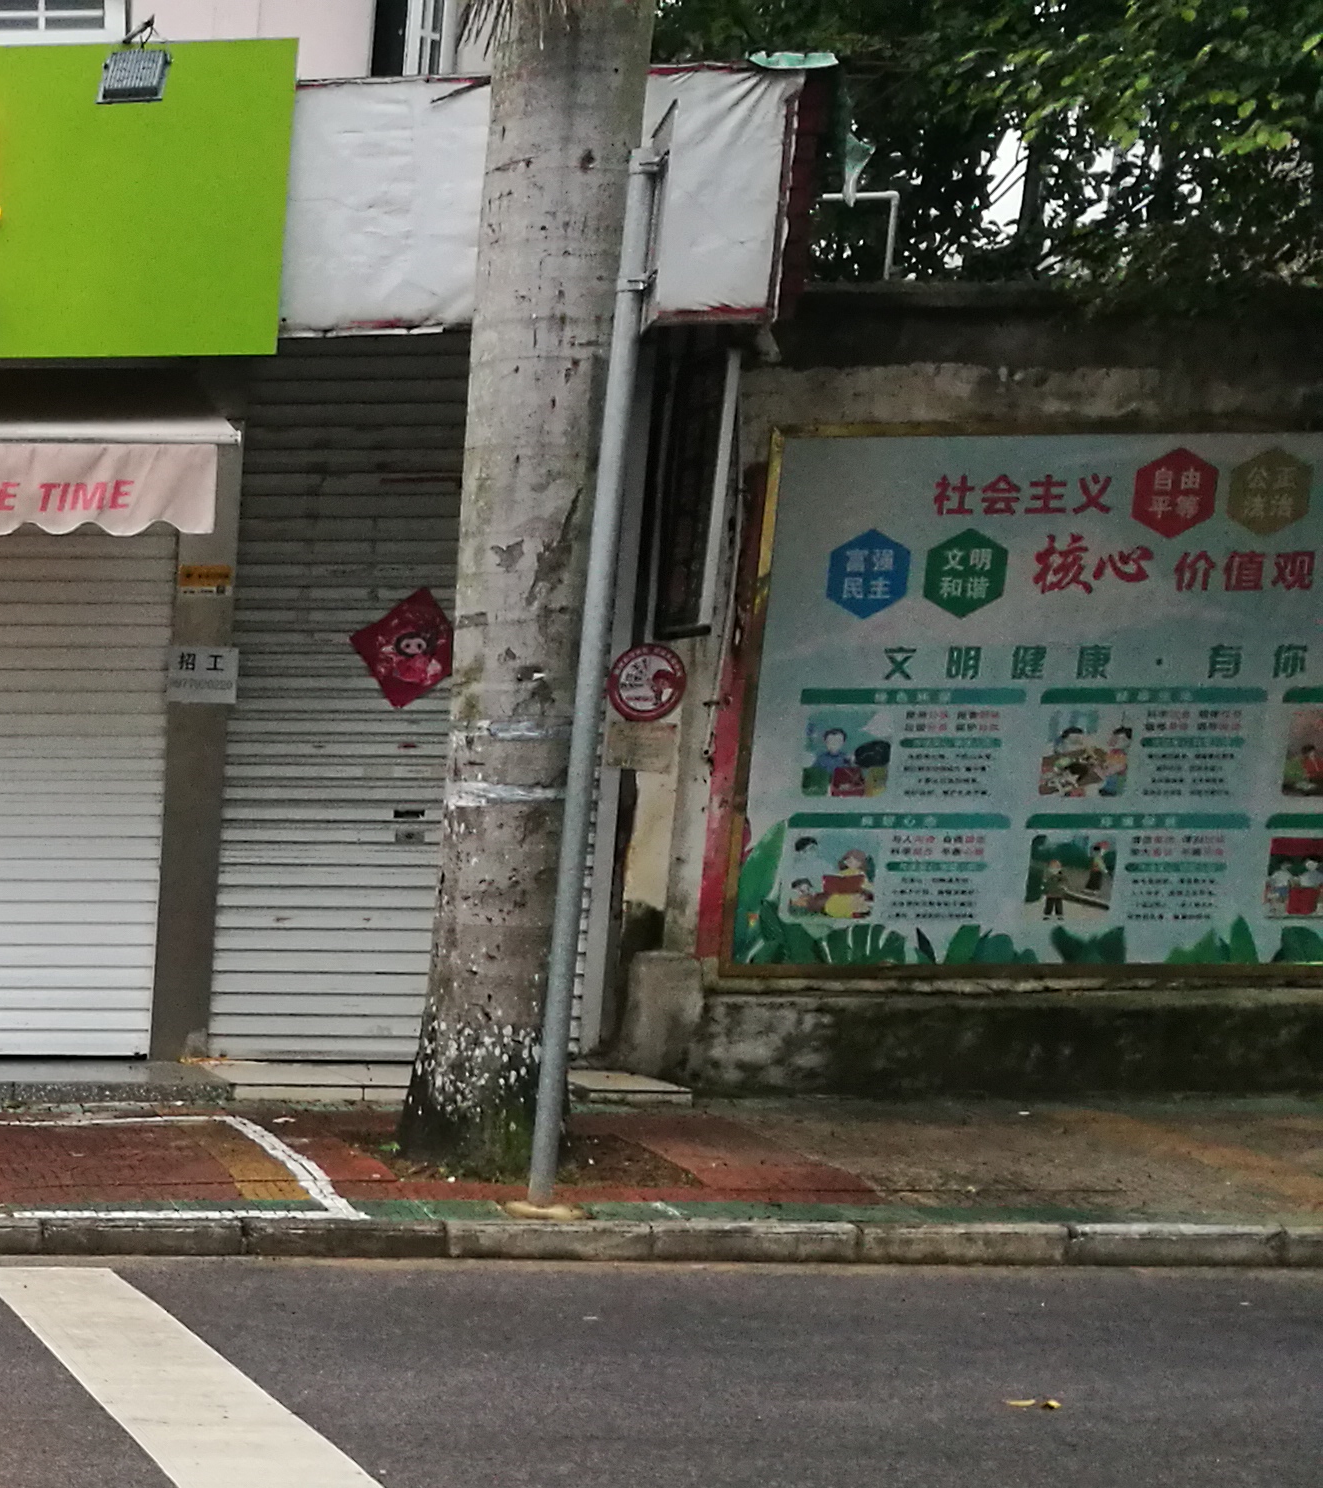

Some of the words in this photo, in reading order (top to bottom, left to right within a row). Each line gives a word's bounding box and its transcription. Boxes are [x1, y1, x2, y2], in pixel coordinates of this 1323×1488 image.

[1154, 467, 1202, 490] 自由
[36, 479, 135, 514] TIME
[933, 473, 1112, 516] 社会主义
[942, 548, 994, 571] 文明
[1032, 533, 1154, 594] 核心
[1173, 549, 1317, 593] 价值观
[841, 576, 892, 599] 民主
[939, 576, 990, 599] 和谐
[177, 652, 224, 671] 招工
